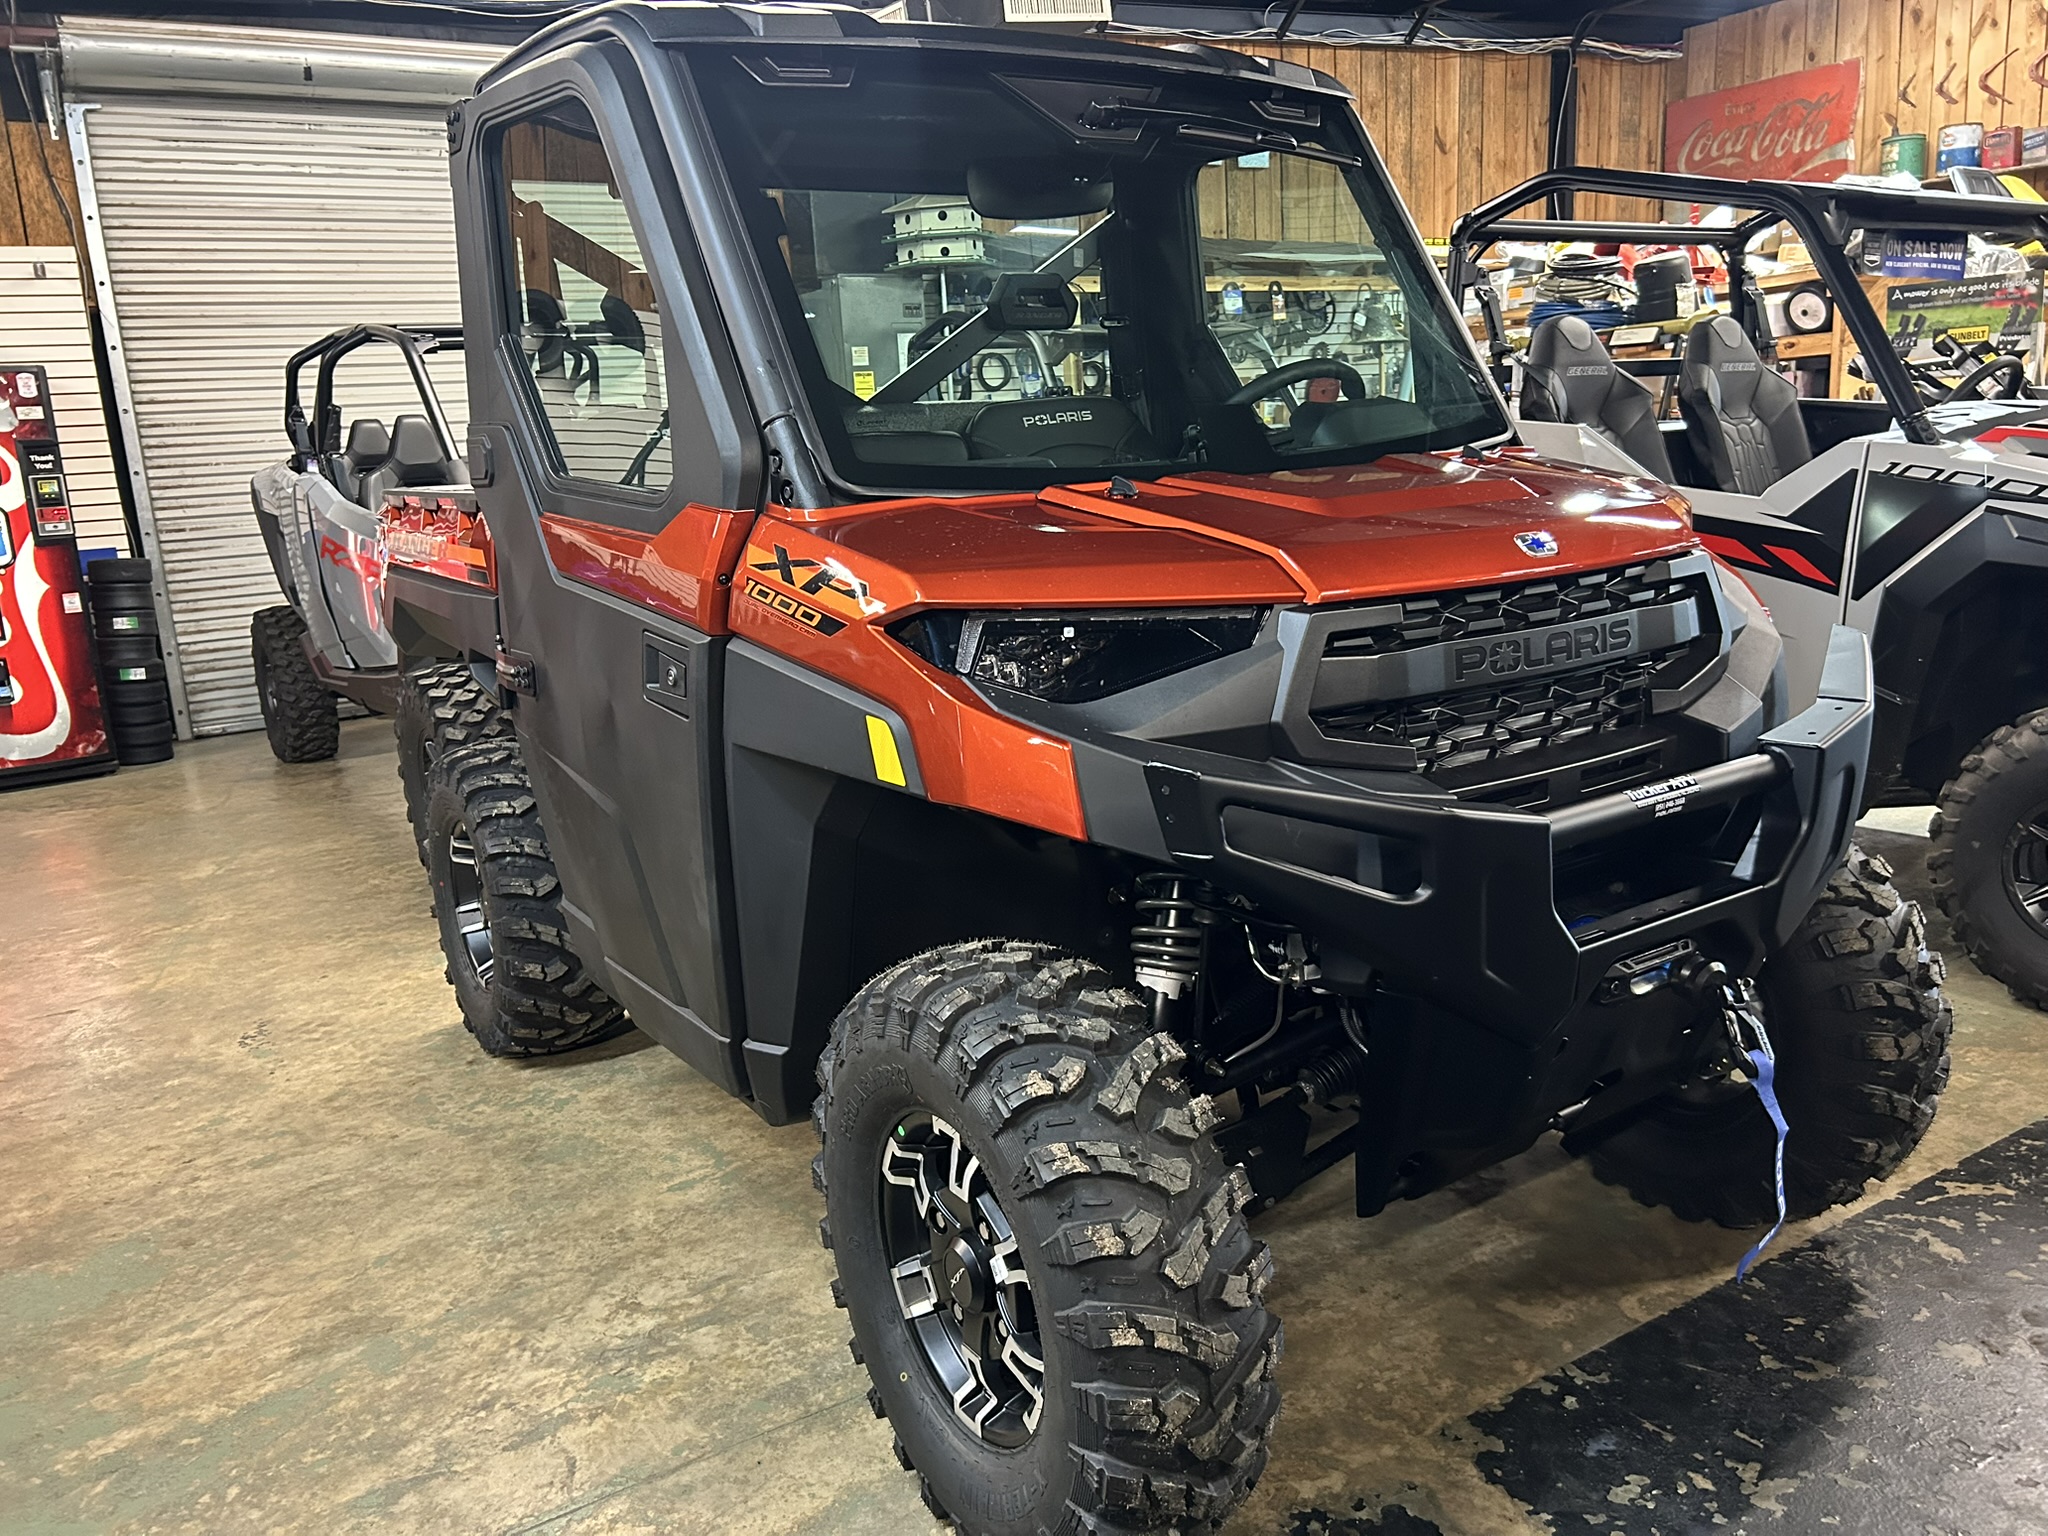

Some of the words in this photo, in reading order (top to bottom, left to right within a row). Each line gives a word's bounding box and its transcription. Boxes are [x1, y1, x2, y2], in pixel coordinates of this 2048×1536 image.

[1677, 84, 1845, 174] Coca-Cola
[1887, 240, 1901, 257] ON
[1904, 241, 1938, 258] SALE
[1940, 242, 1964, 261] NOW
[1892, 289, 1903, 300] A
[1904, 289, 1930, 298] mower
[1931, 286, 1938, 296] is
[1939, 286, 1957, 298] only
[1957, 285, 1967, 294] as
[1968, 282, 1988, 295] good
[1990, 281, 2000, 290] as
[2015, 277, 2040, 288] blade
[1567, 366, 1608, 376] GENERAL
[1720, 362, 1756, 372] GENERAL
[1022, 410, 1093, 427] POLARIS
[34, 462, 53, 470] You!
[749, 543, 869, 600] XP
[743, 579, 823, 627] 1000
[744, 599, 760, 611] DUAL
[761, 607, 799, 629] OVERHEAD
[799, 626, 817, 638] CAM
[1455, 618, 1632, 683] POLARIS
[1622, 783, 1670, 801] Tucker
[1668, 774, 1697, 789] ATV
